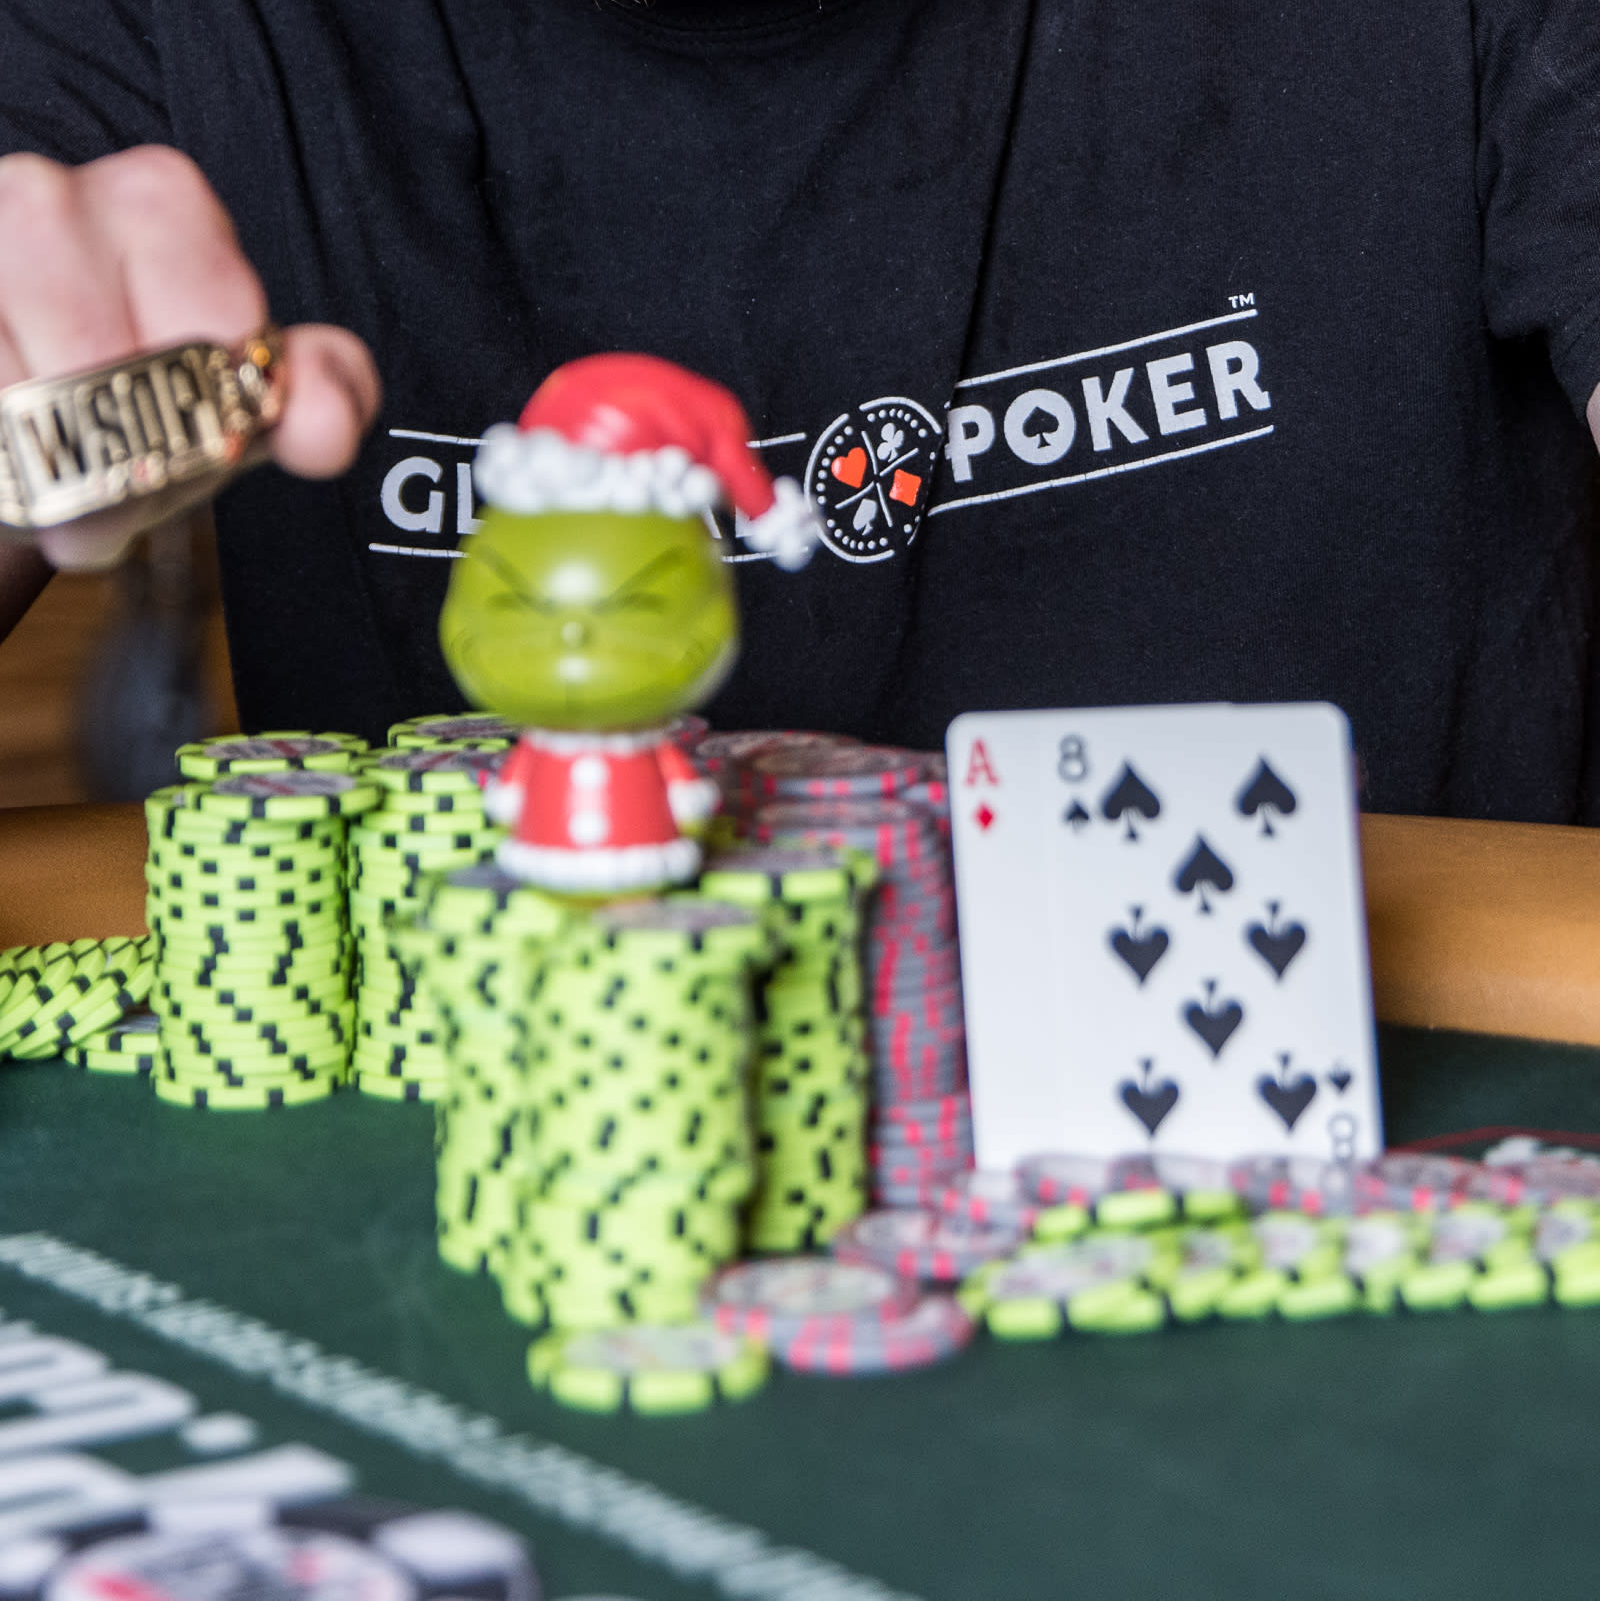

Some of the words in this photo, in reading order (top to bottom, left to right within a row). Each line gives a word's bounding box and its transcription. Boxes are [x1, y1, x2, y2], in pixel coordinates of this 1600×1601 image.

[1228, 292, 1255, 309] TM
[948, 340, 1271, 483] POKER
[966, 739, 999, 787] A
[1058, 734, 1089, 782] 8
